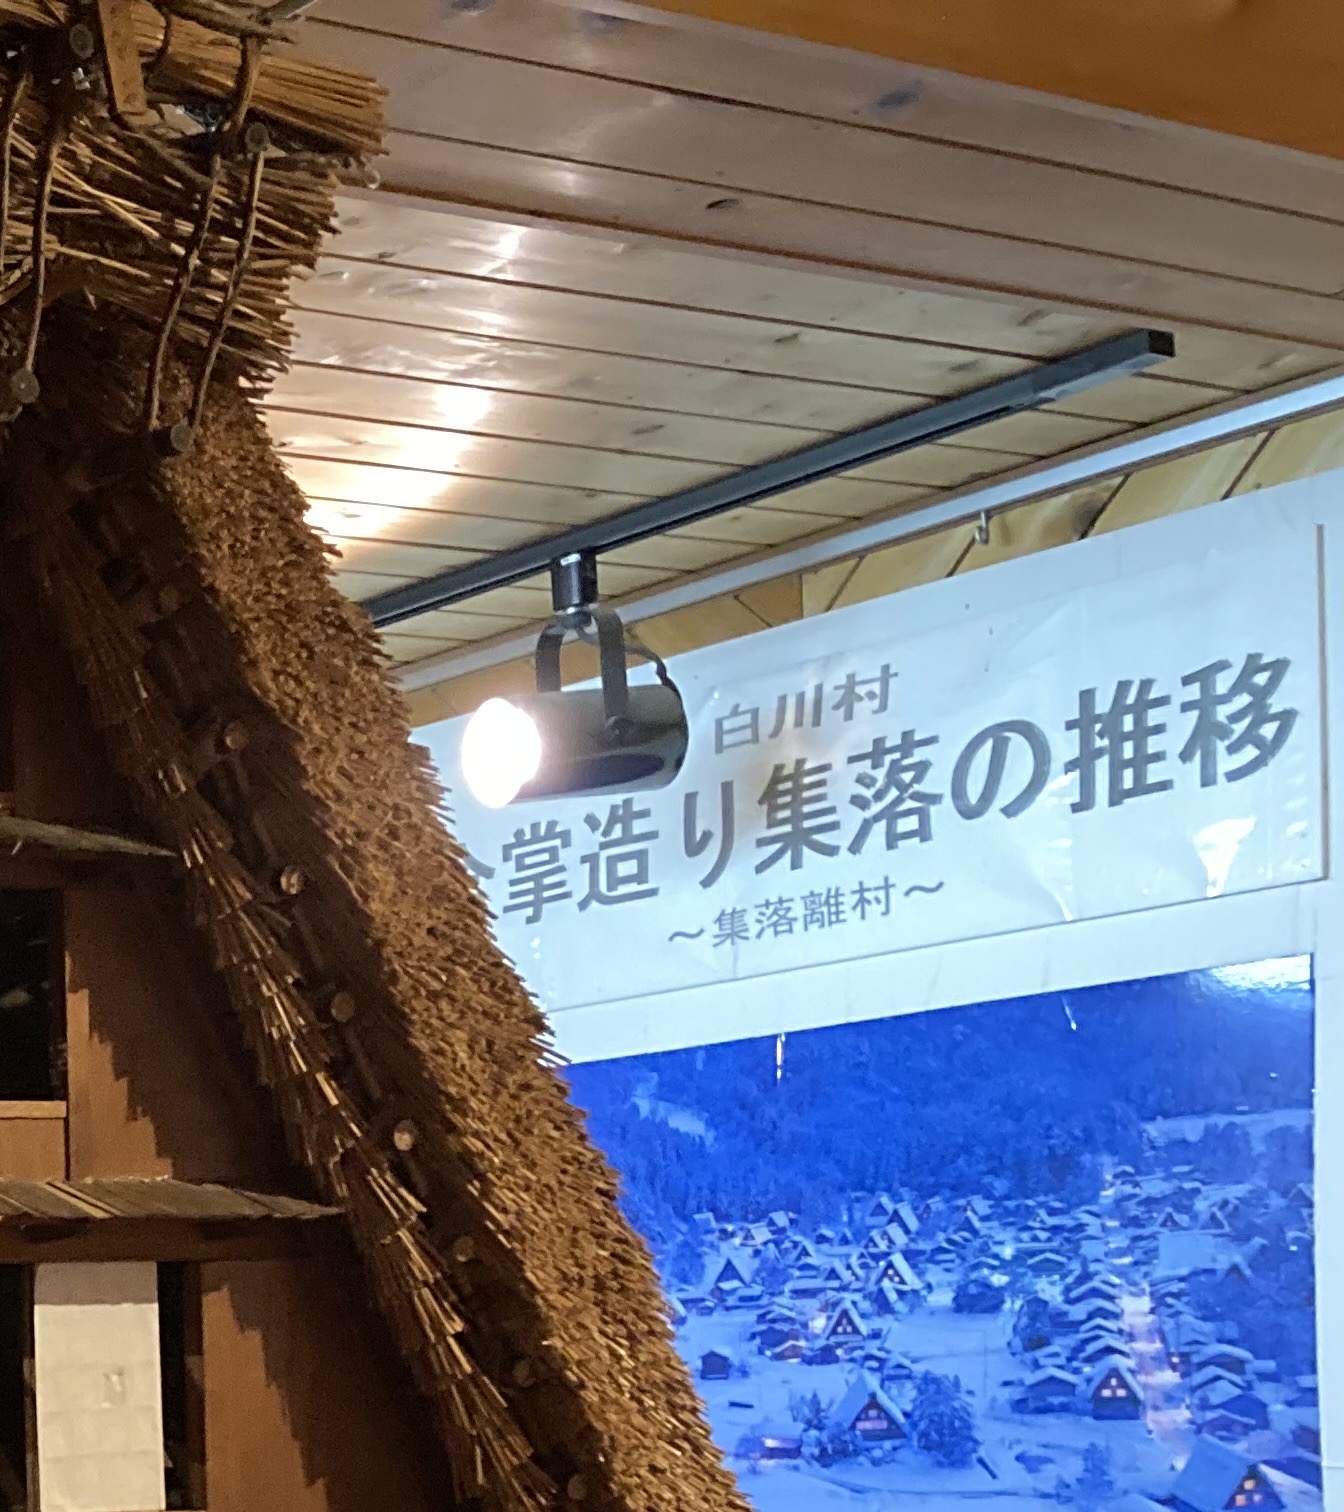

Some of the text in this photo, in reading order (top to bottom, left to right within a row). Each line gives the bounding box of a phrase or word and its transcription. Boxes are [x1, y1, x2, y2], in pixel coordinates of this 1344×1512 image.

[465, 652, 1300, 926] 掌造り集落の推移
[714, 663, 900, 757] 白川村
